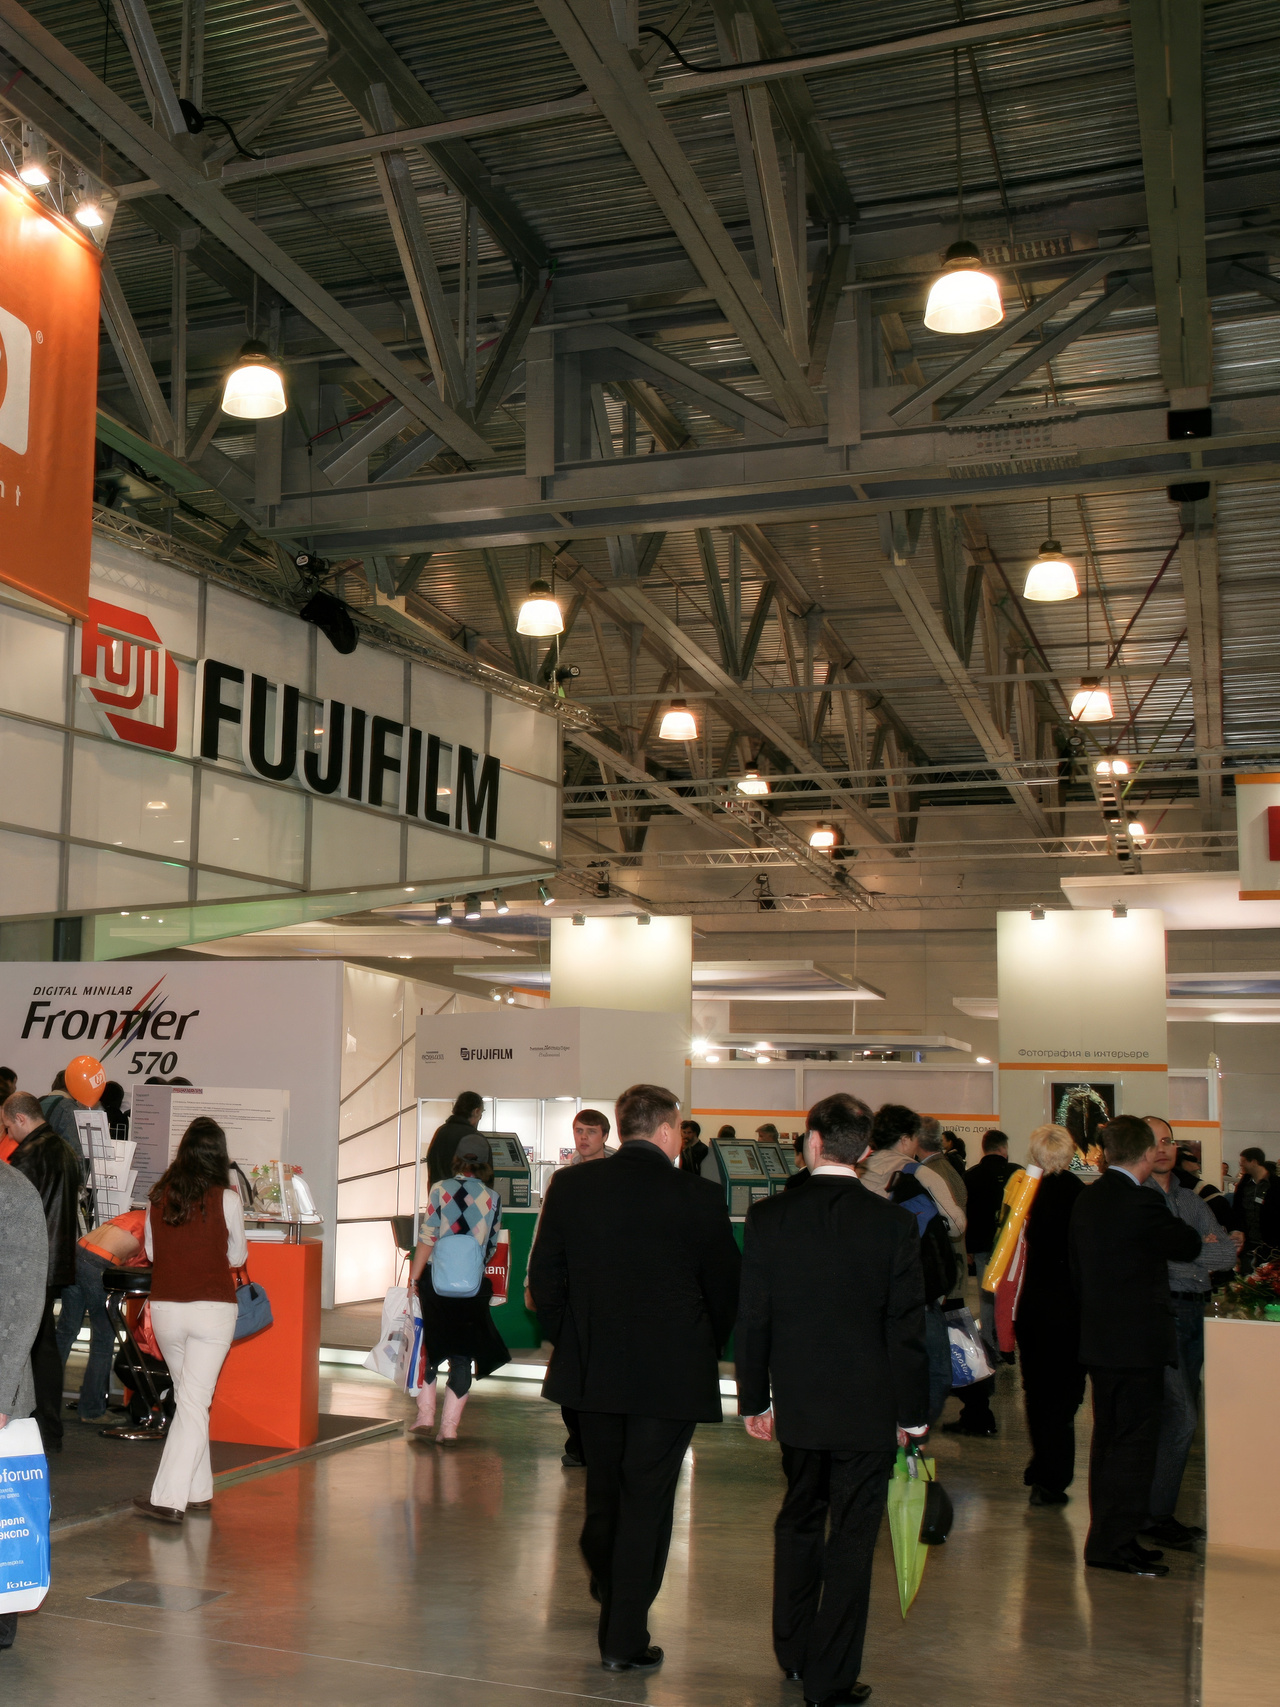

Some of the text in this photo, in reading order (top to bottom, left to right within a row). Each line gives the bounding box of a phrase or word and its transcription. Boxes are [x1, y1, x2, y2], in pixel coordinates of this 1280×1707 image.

[196, 659, 501, 840] FUJIFILM
[33, 986, 133, 996] DIGITAL MINILAB
[21, 1001, 200, 1041] Frontier
[470, 1048, 513, 1060] FUJIFILM
[1018, 1048, 1082, 1058] Фотография
[1094, 1050, 1150, 1059] интерьере
[128, 1051, 178, 1075] 570
